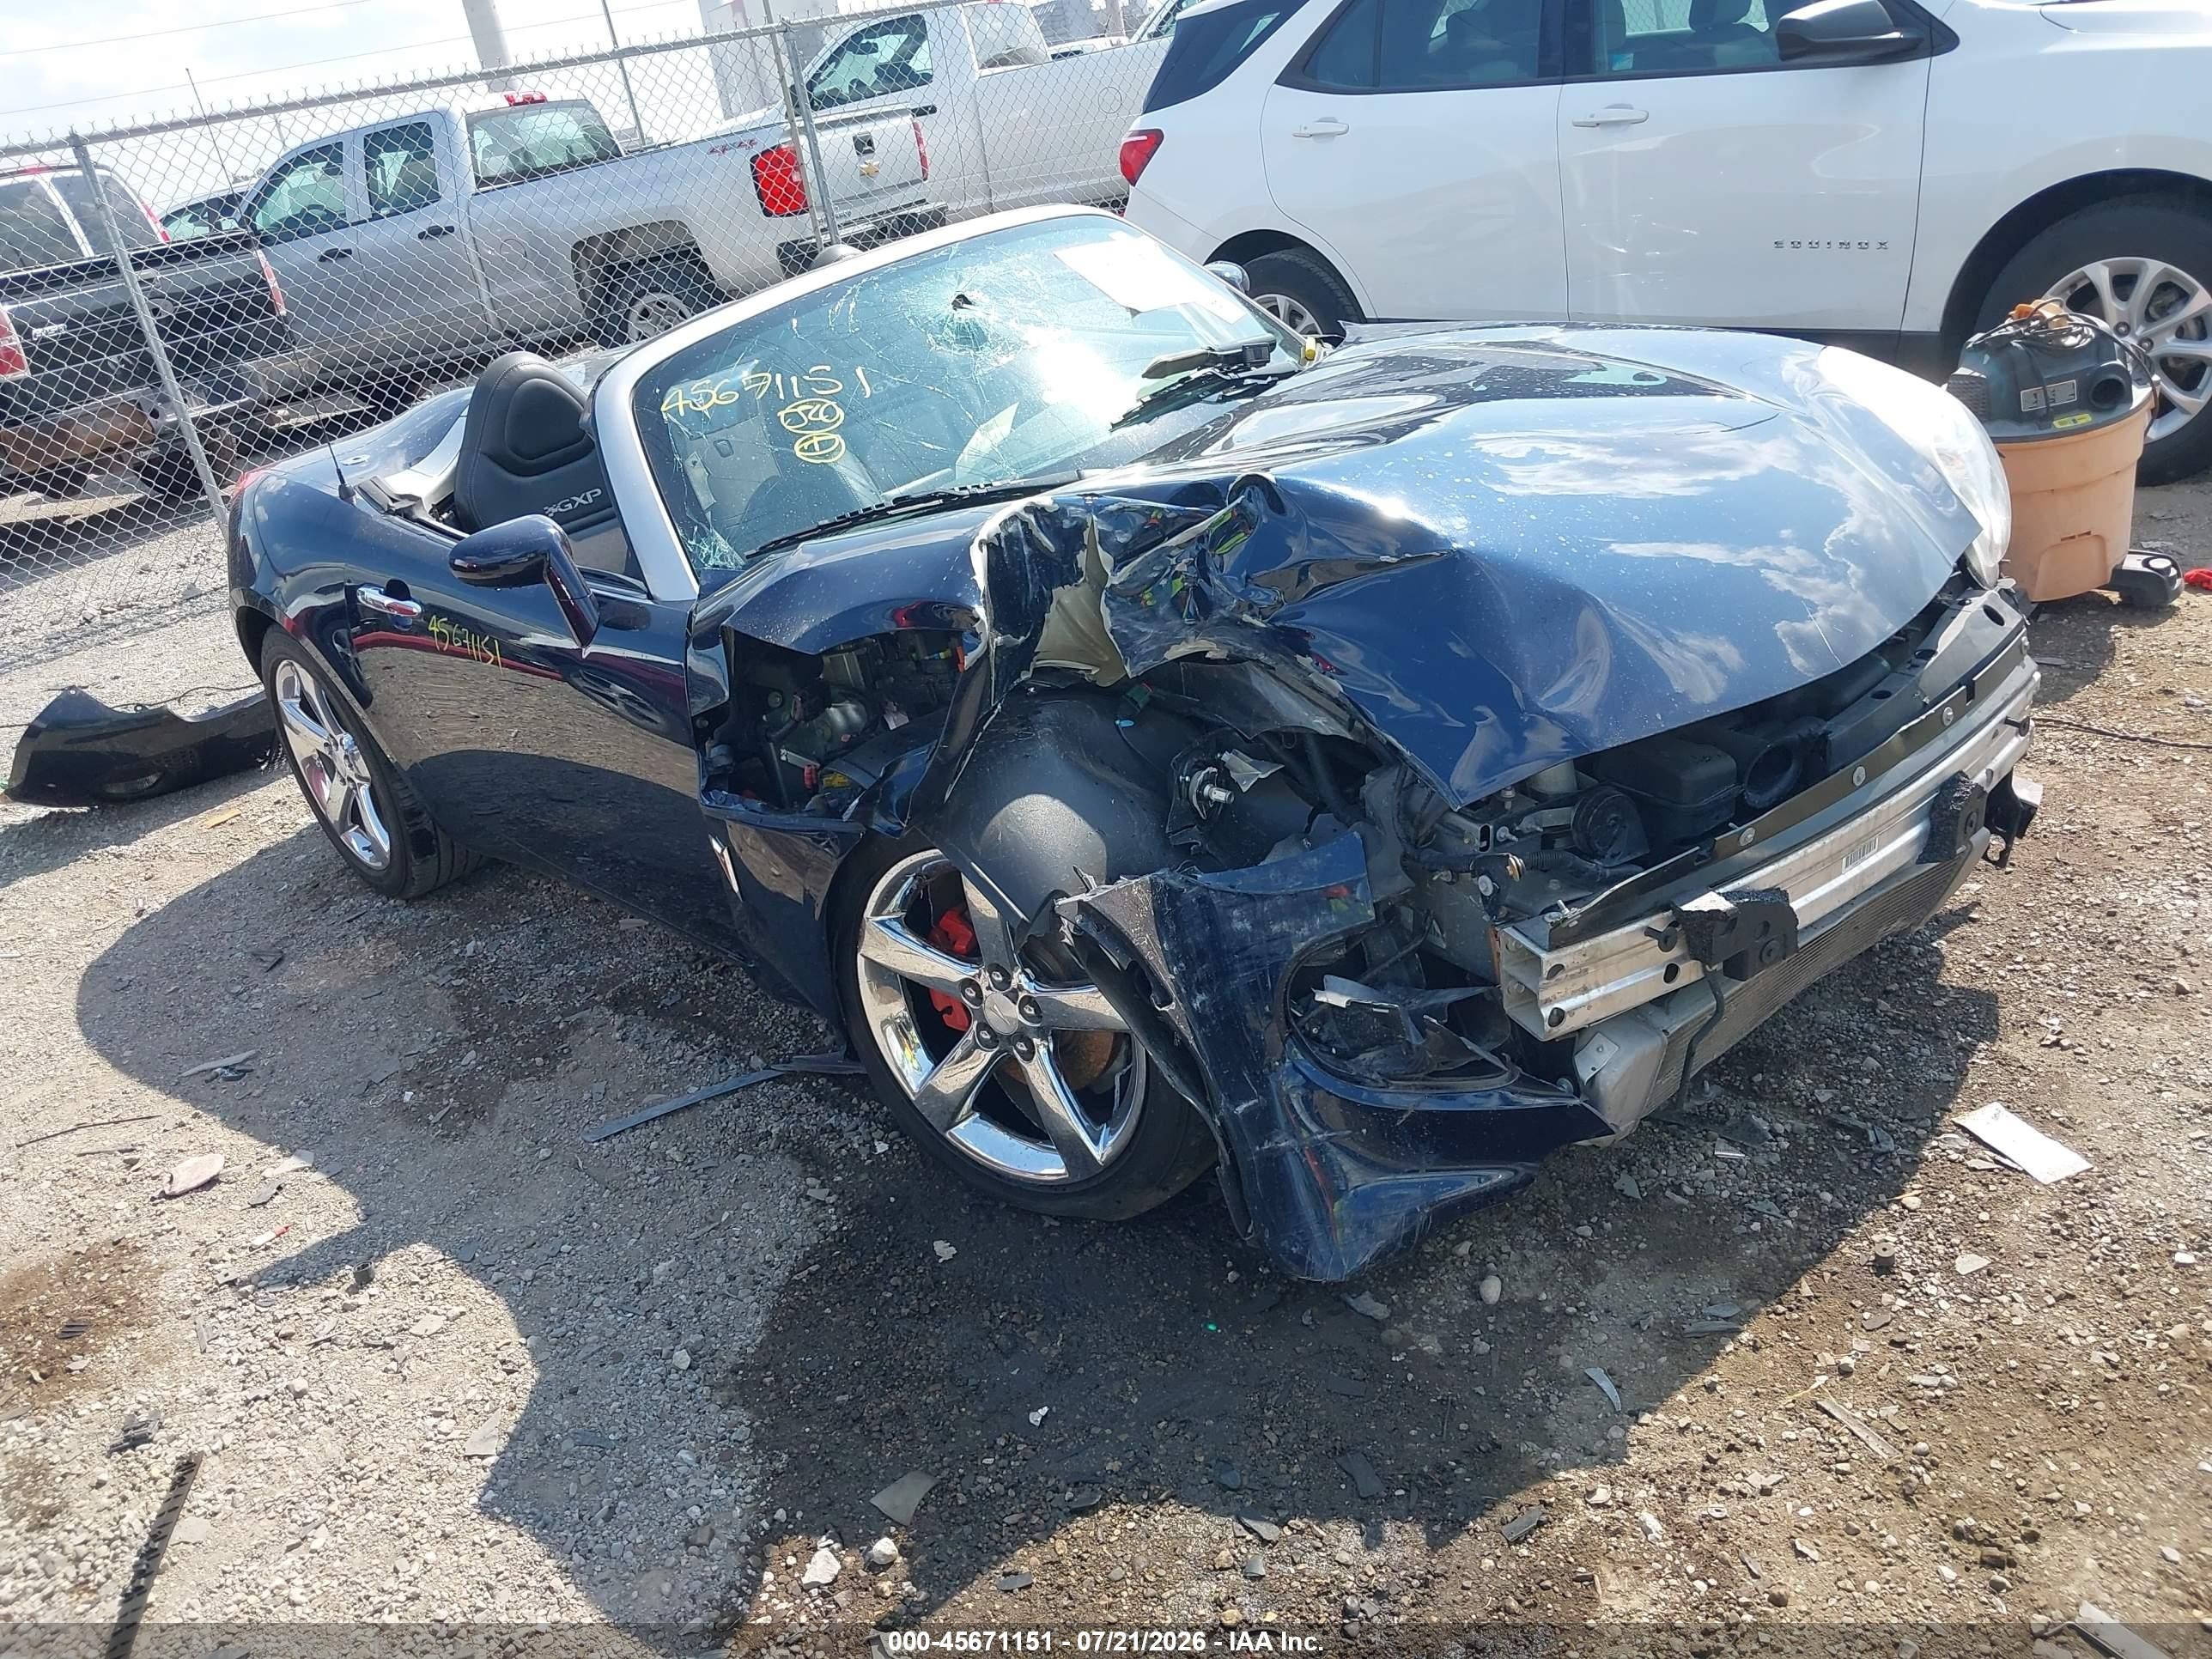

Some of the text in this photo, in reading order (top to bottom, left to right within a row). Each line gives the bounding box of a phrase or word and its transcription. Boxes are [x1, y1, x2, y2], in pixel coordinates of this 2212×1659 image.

[1773, 240, 1889, 250] EQUINOX
[557, 488, 602, 513] GXP
[428, 614, 502, 675] 45671151
